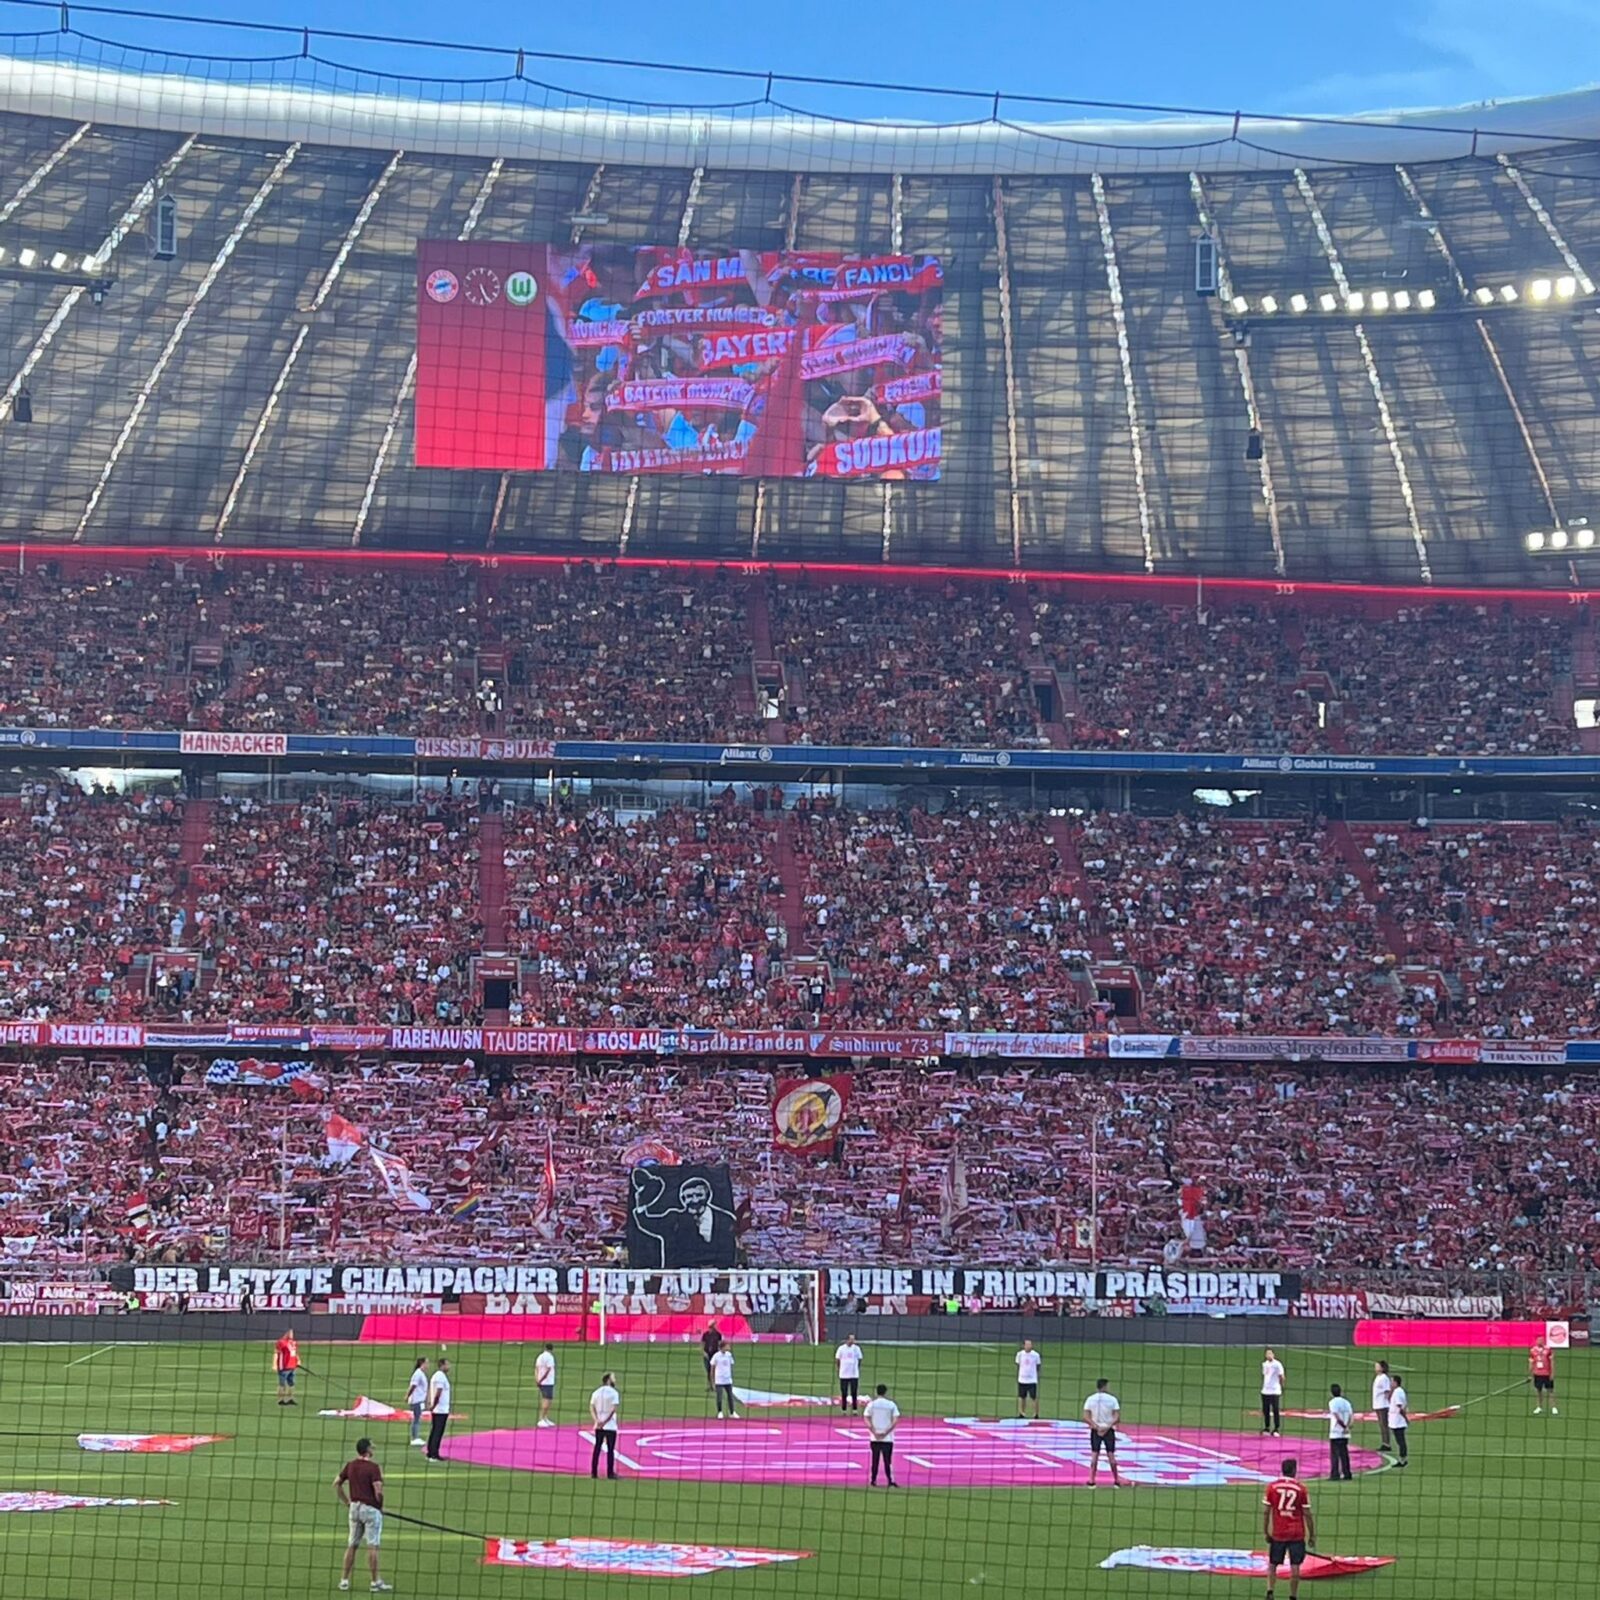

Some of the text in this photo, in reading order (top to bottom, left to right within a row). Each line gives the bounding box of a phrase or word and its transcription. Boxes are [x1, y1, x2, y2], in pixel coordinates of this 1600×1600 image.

[638, 309, 703, 327] FOREVER
[183, 735, 286, 754] HAINSACKER
[415, 739, 557, 759] GIESSEN BULLS
[723, 749, 758, 760] Allianz
[960, 753, 995, 765] Allianz
[1242, 758, 1375, 771] Allianz Global Investors
[393, 1029, 482, 1050] RABENAU/SN
[487, 1031, 576, 1052] TAUBERTAL
[598, 1031, 660, 1052] RÖSLAU
[1490, 1052, 1559, 1062] TRAUNSTEIN
[134, 1267, 198, 1293] DER
[208, 1267, 333, 1295] LETZTE
[342, 1267, 559, 1295] CHAMPAGNER
[568, 1267, 651, 1294] GEHT
[659, 1268, 718, 1295] AUF
[829, 1268, 913, 1296] RUHE
[921, 1270, 954, 1297] IN
[963, 1270, 1096, 1298] FRIEDEN
[1105, 1265, 1281, 1299] PRÄSIDENT
[1372, 1293, 1502, 1315] ANZENKIRCHEN
[1276, 1488, 1298, 1511] 72
